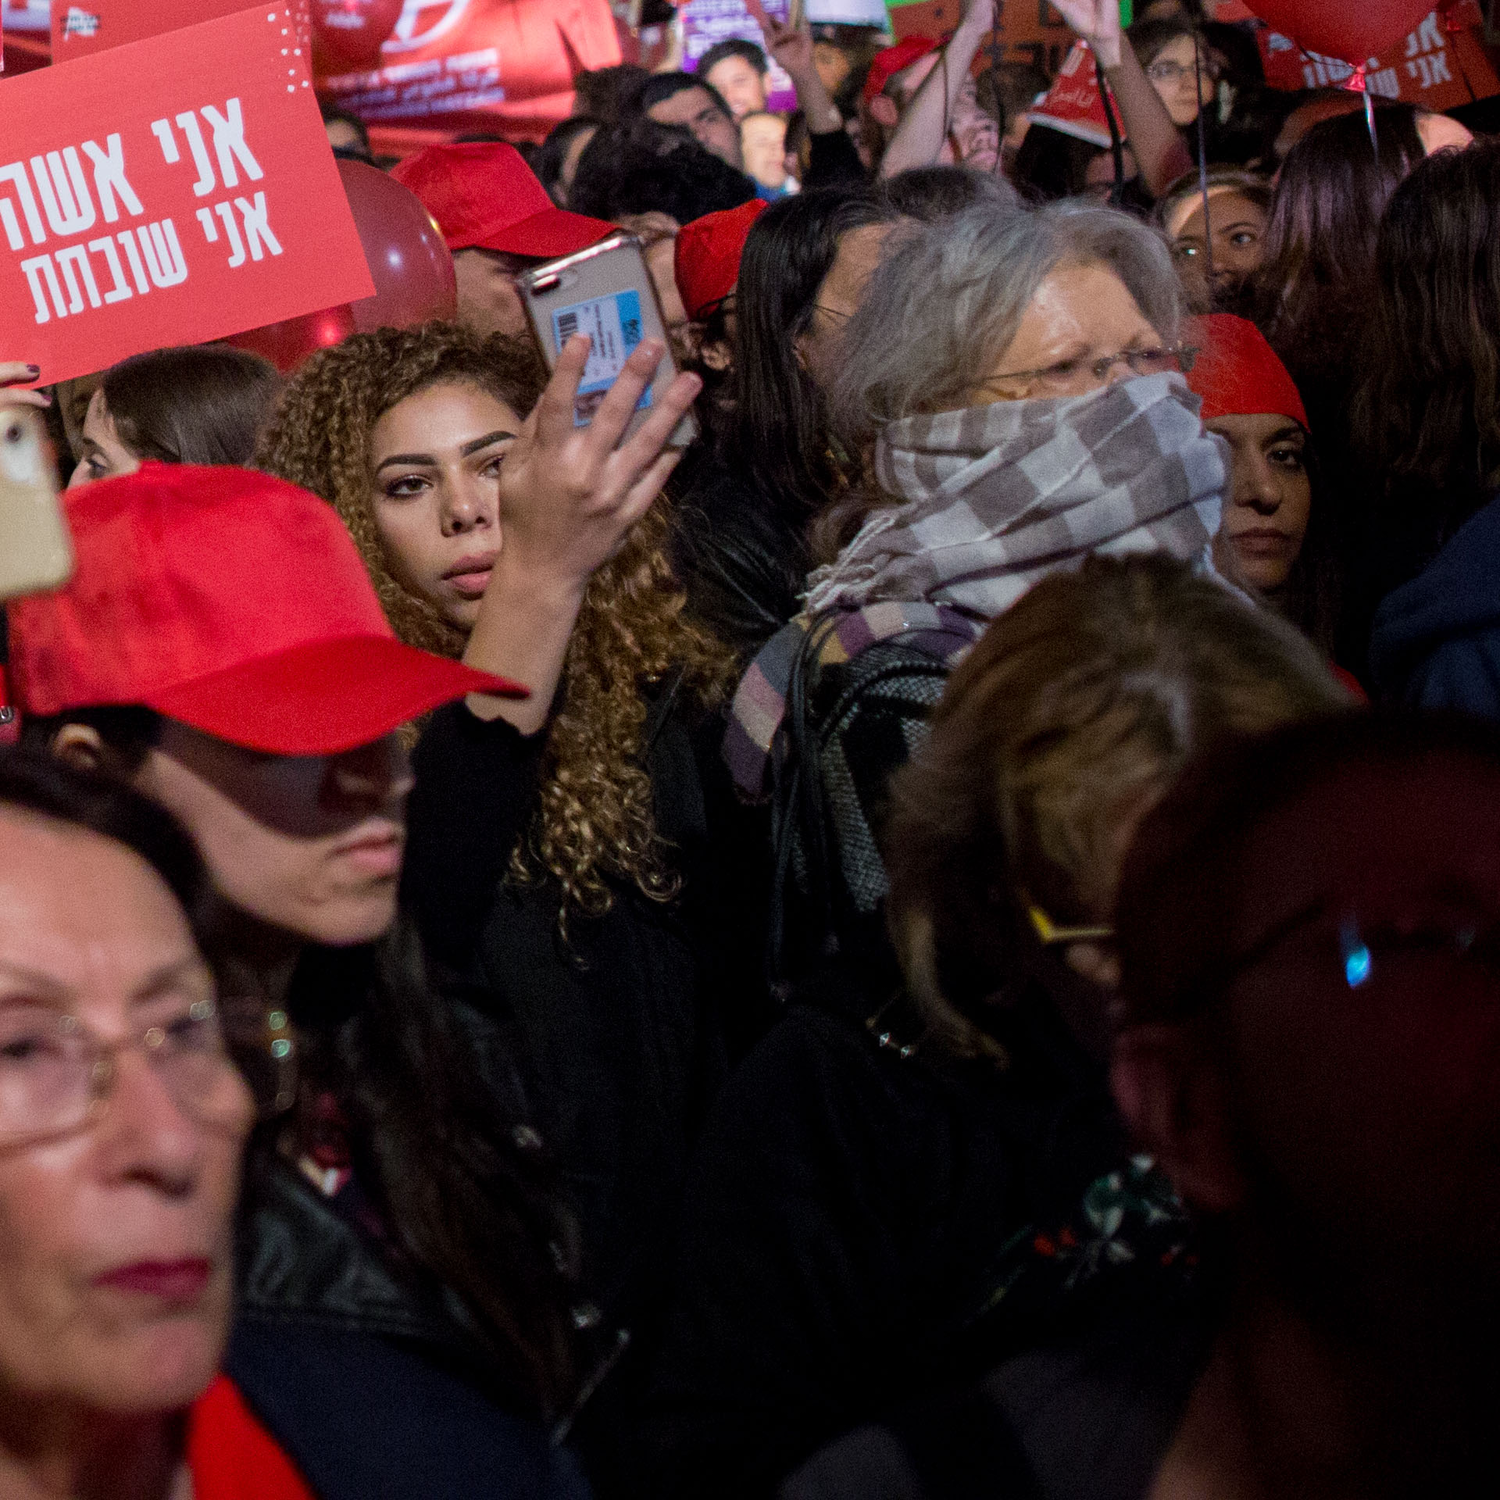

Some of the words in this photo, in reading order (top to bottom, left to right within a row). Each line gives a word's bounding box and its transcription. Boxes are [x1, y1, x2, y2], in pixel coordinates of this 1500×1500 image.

[150, 97, 264, 197] אני
[20, 218, 188, 325] שובתת
[195, 191, 284, 268] אני
